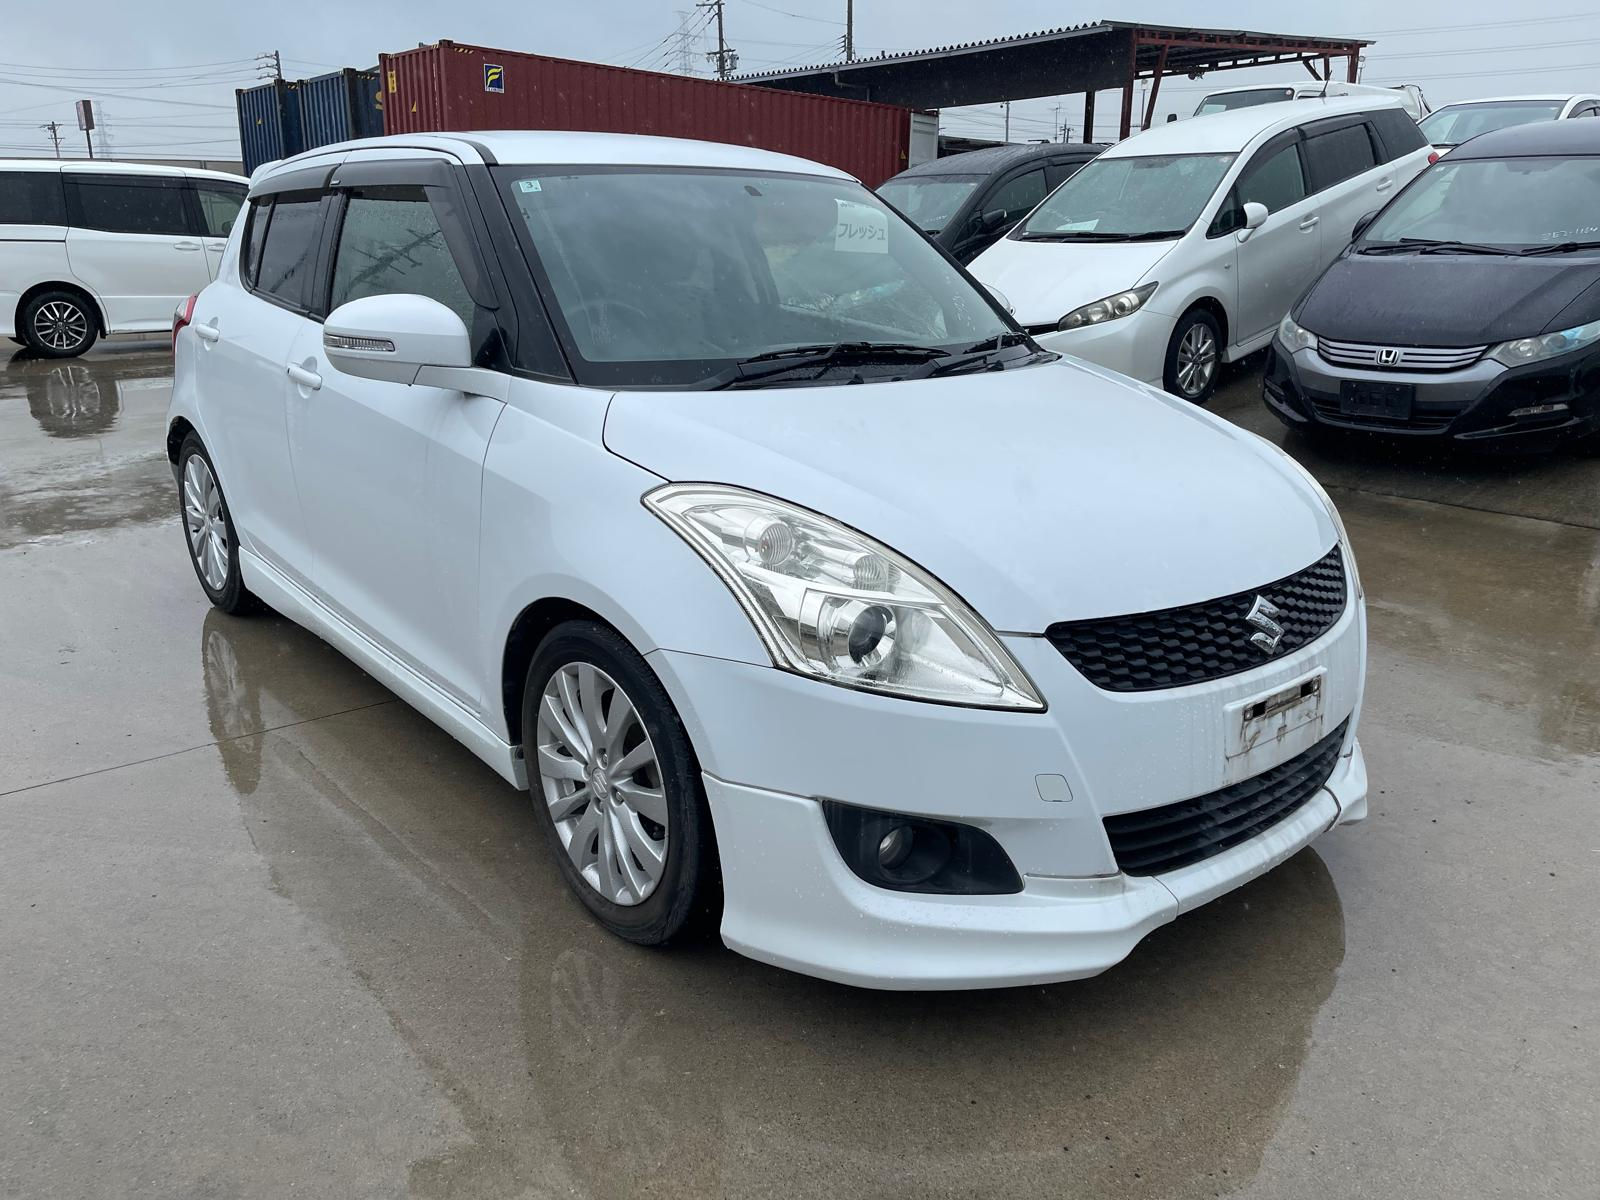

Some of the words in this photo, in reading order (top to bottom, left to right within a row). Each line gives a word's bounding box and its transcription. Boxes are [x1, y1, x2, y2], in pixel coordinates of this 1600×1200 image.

[838, 223, 886, 240] フレッシュ
